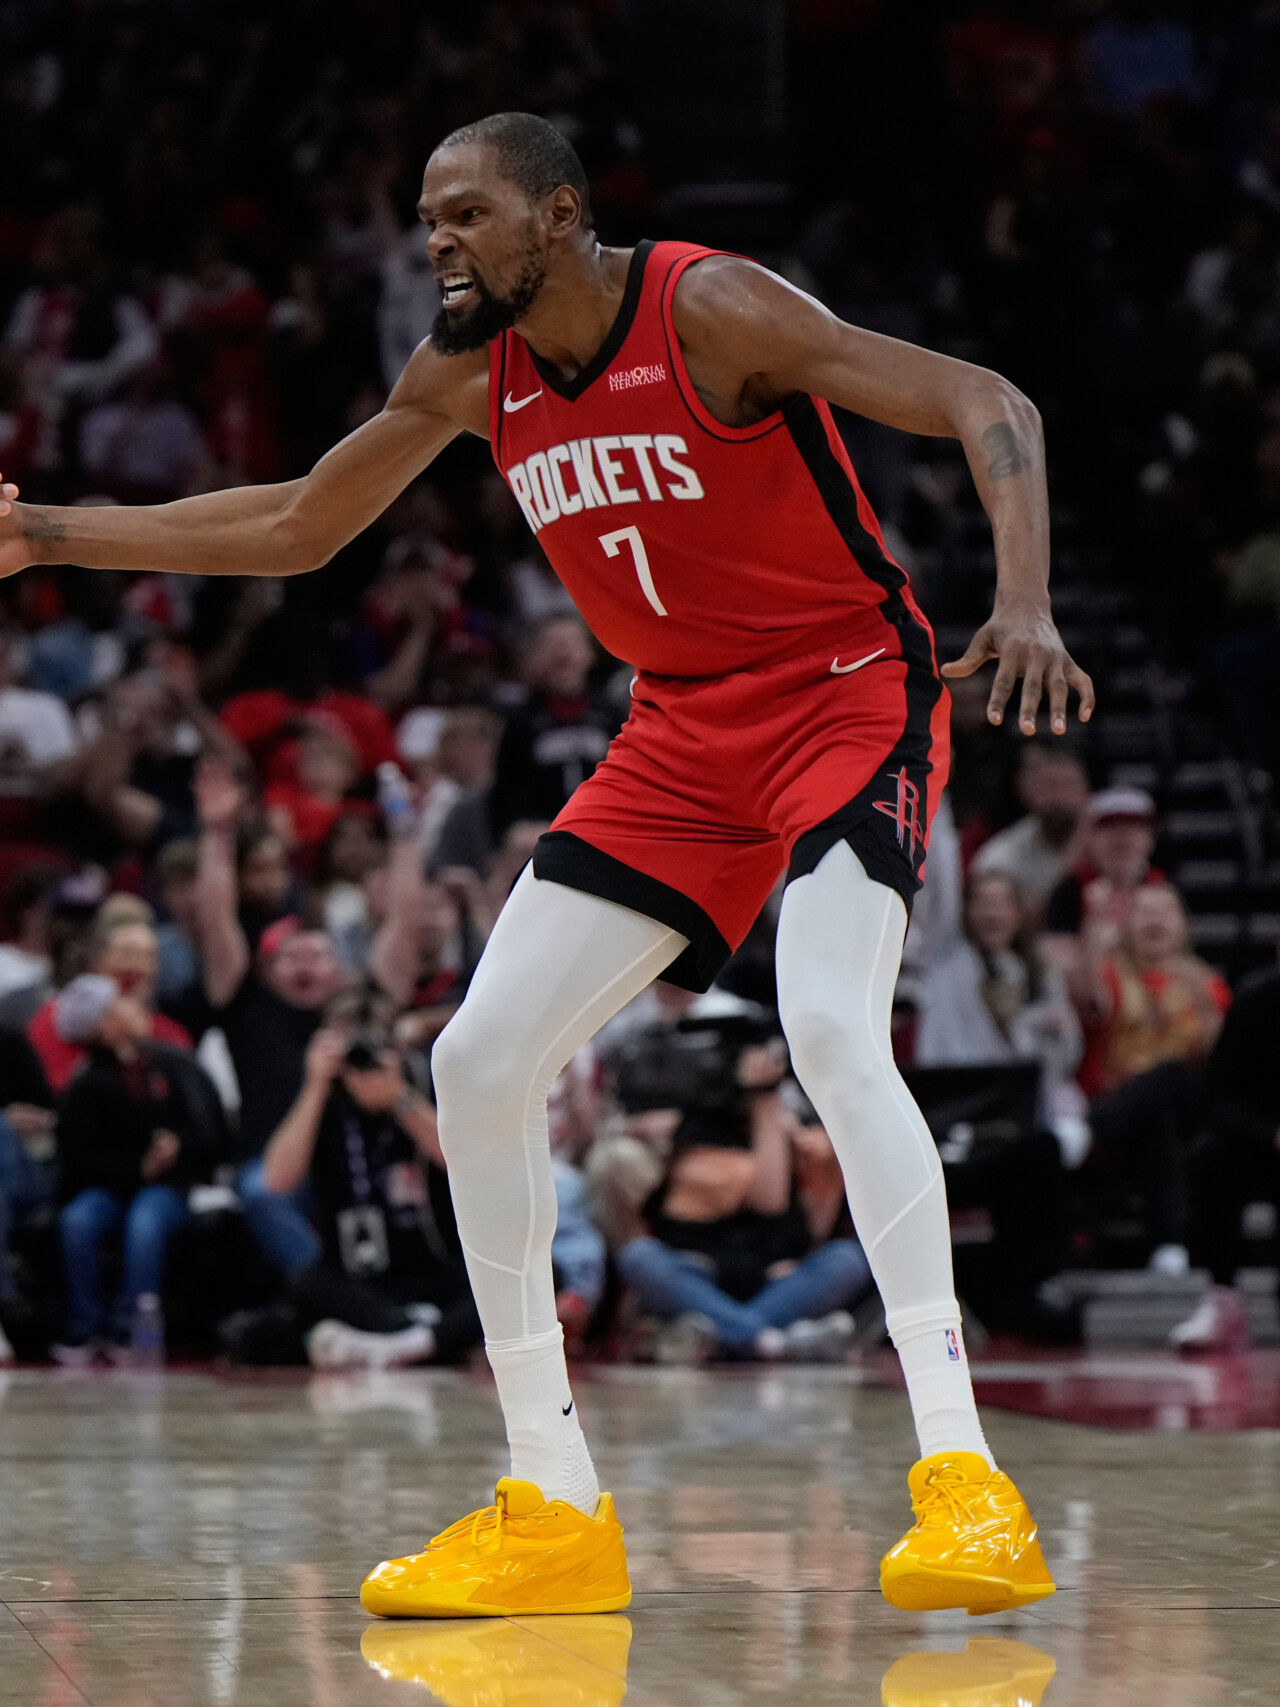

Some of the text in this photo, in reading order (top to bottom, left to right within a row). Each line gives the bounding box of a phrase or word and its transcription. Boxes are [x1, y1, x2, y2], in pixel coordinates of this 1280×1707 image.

[609, 363, 666, 383] MEMORIAL
[609, 369, 666, 391] HERMANN
[506, 434, 705, 536] ROCKETS
[598, 525, 668, 616] 7
